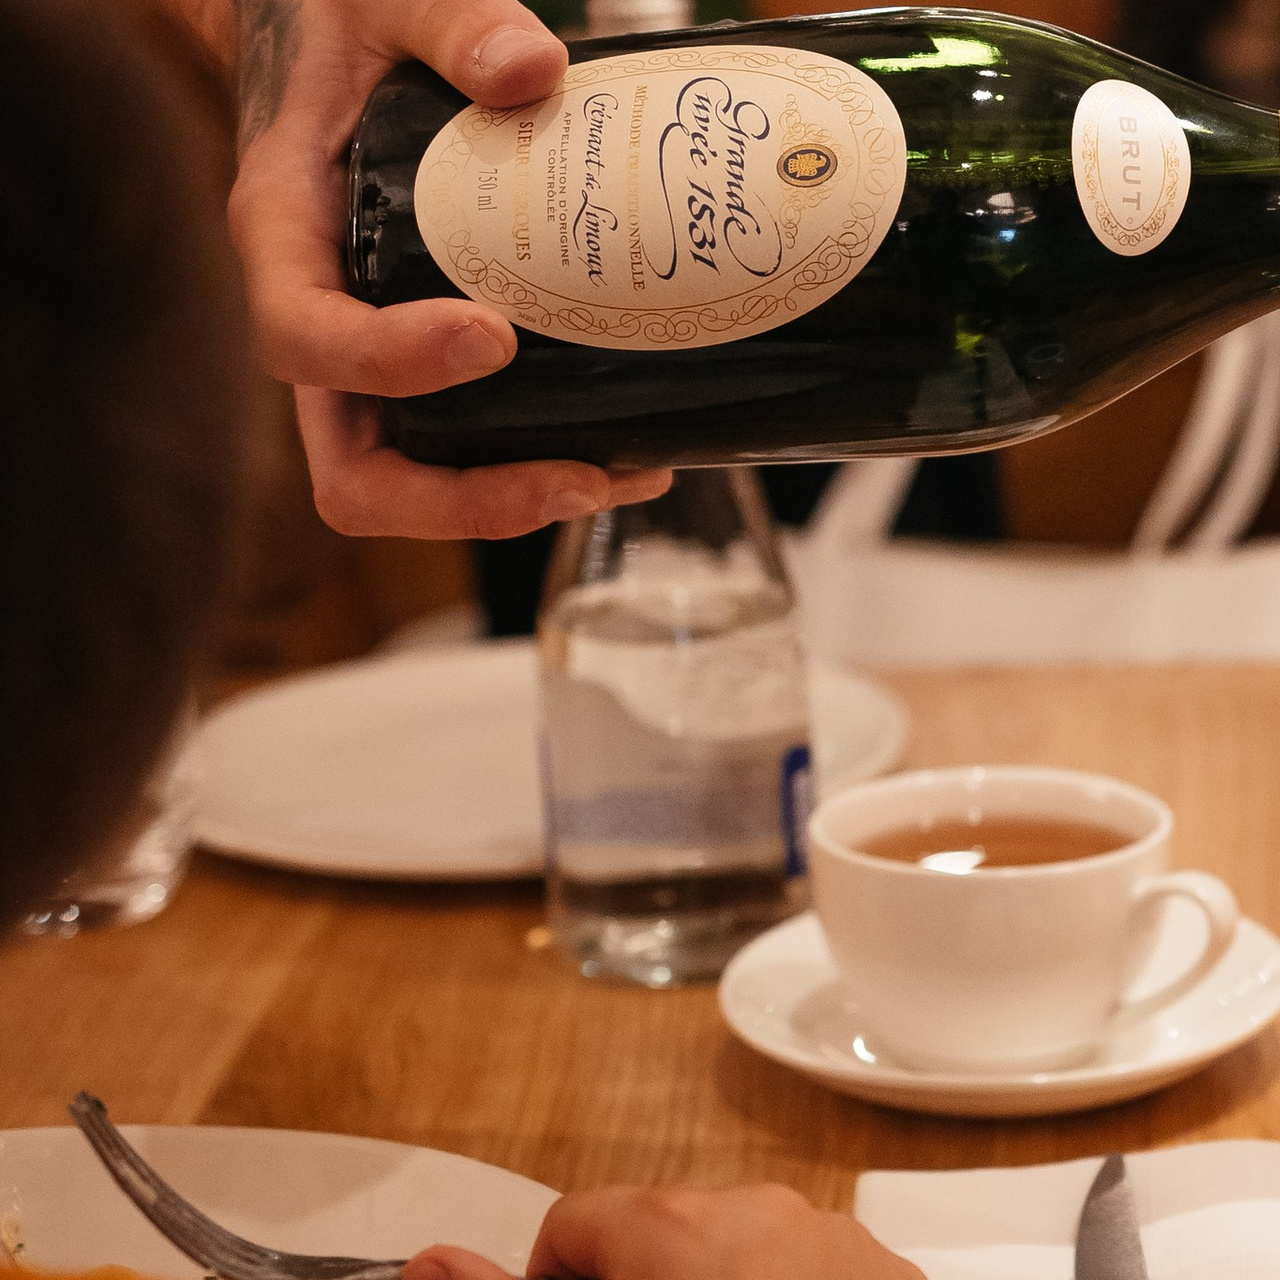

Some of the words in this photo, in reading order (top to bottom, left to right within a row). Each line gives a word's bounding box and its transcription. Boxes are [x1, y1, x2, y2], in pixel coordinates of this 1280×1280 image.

[516, 121, 533, 165] SIEUR
[559, 112, 572, 194] APPELLATION
[583, 93, 619, 174] Crémant
[629, 85, 648, 149] MÉTHODE
[478, 168, 498, 190] 750
[547, 149, 557, 222] CONTRÔLÉE
[586, 173, 601, 190] de
[719, 101, 771, 236] Grande
[1119, 116, 1141, 211] BRUT
[478, 196, 497, 210] ml
[512, 173, 531, 261] DRQUES
[559, 200, 570, 267] D'ORIGINE
[573, 190, 619, 287] Limoux
[686, 176, 721, 275] 1531
